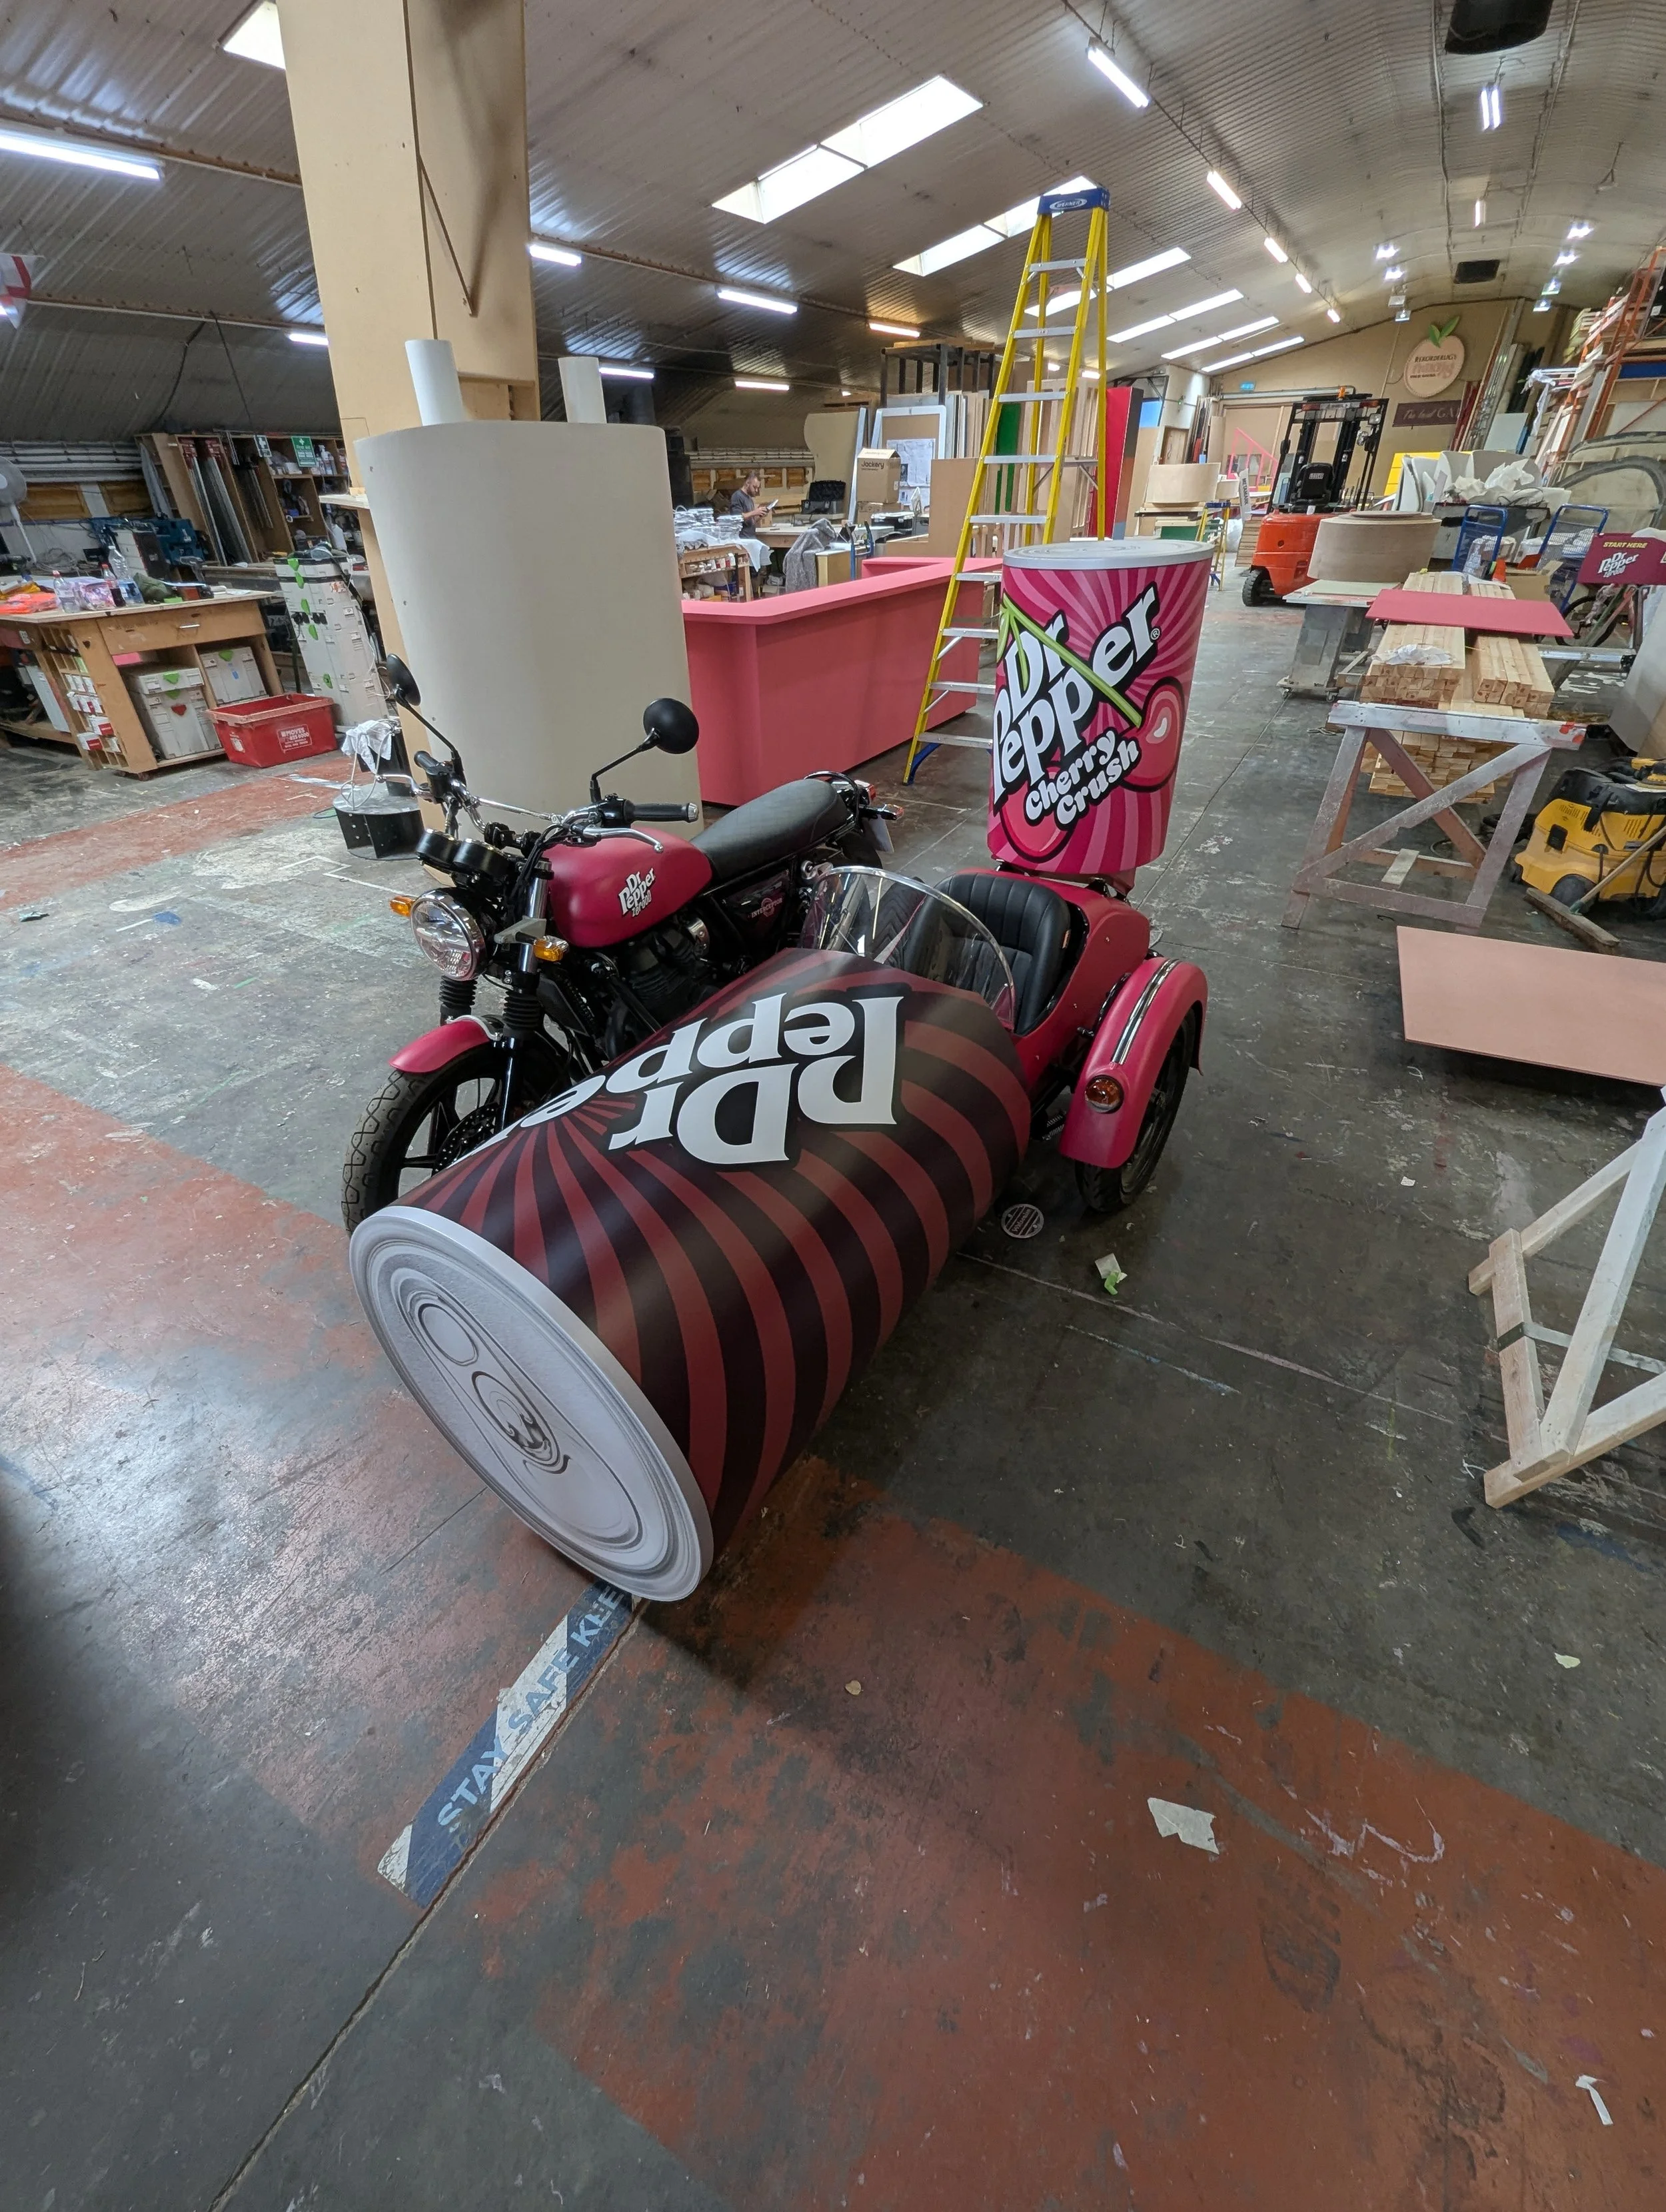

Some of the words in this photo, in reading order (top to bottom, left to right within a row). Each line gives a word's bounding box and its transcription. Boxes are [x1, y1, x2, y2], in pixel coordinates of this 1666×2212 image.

[861, 460, 884, 470] Jackery
[1597, 554, 1639, 574] Pepper
[1611, 552, 1627, 563] Dr
[1005, 614, 1065, 722] Dr
[993, 586, 1156, 805] Pepper
[618, 867, 655, 915] Pepper
[626, 871, 642, 894] Dr
[751, 897, 783, 919] INTERCEPTOR
[608, 1063, 800, 1165] Dr
[437, 1736, 510, 1834] STAY
[508, 1648, 579, 1731] SAFE
[570, 1585, 624, 1647] KEE
